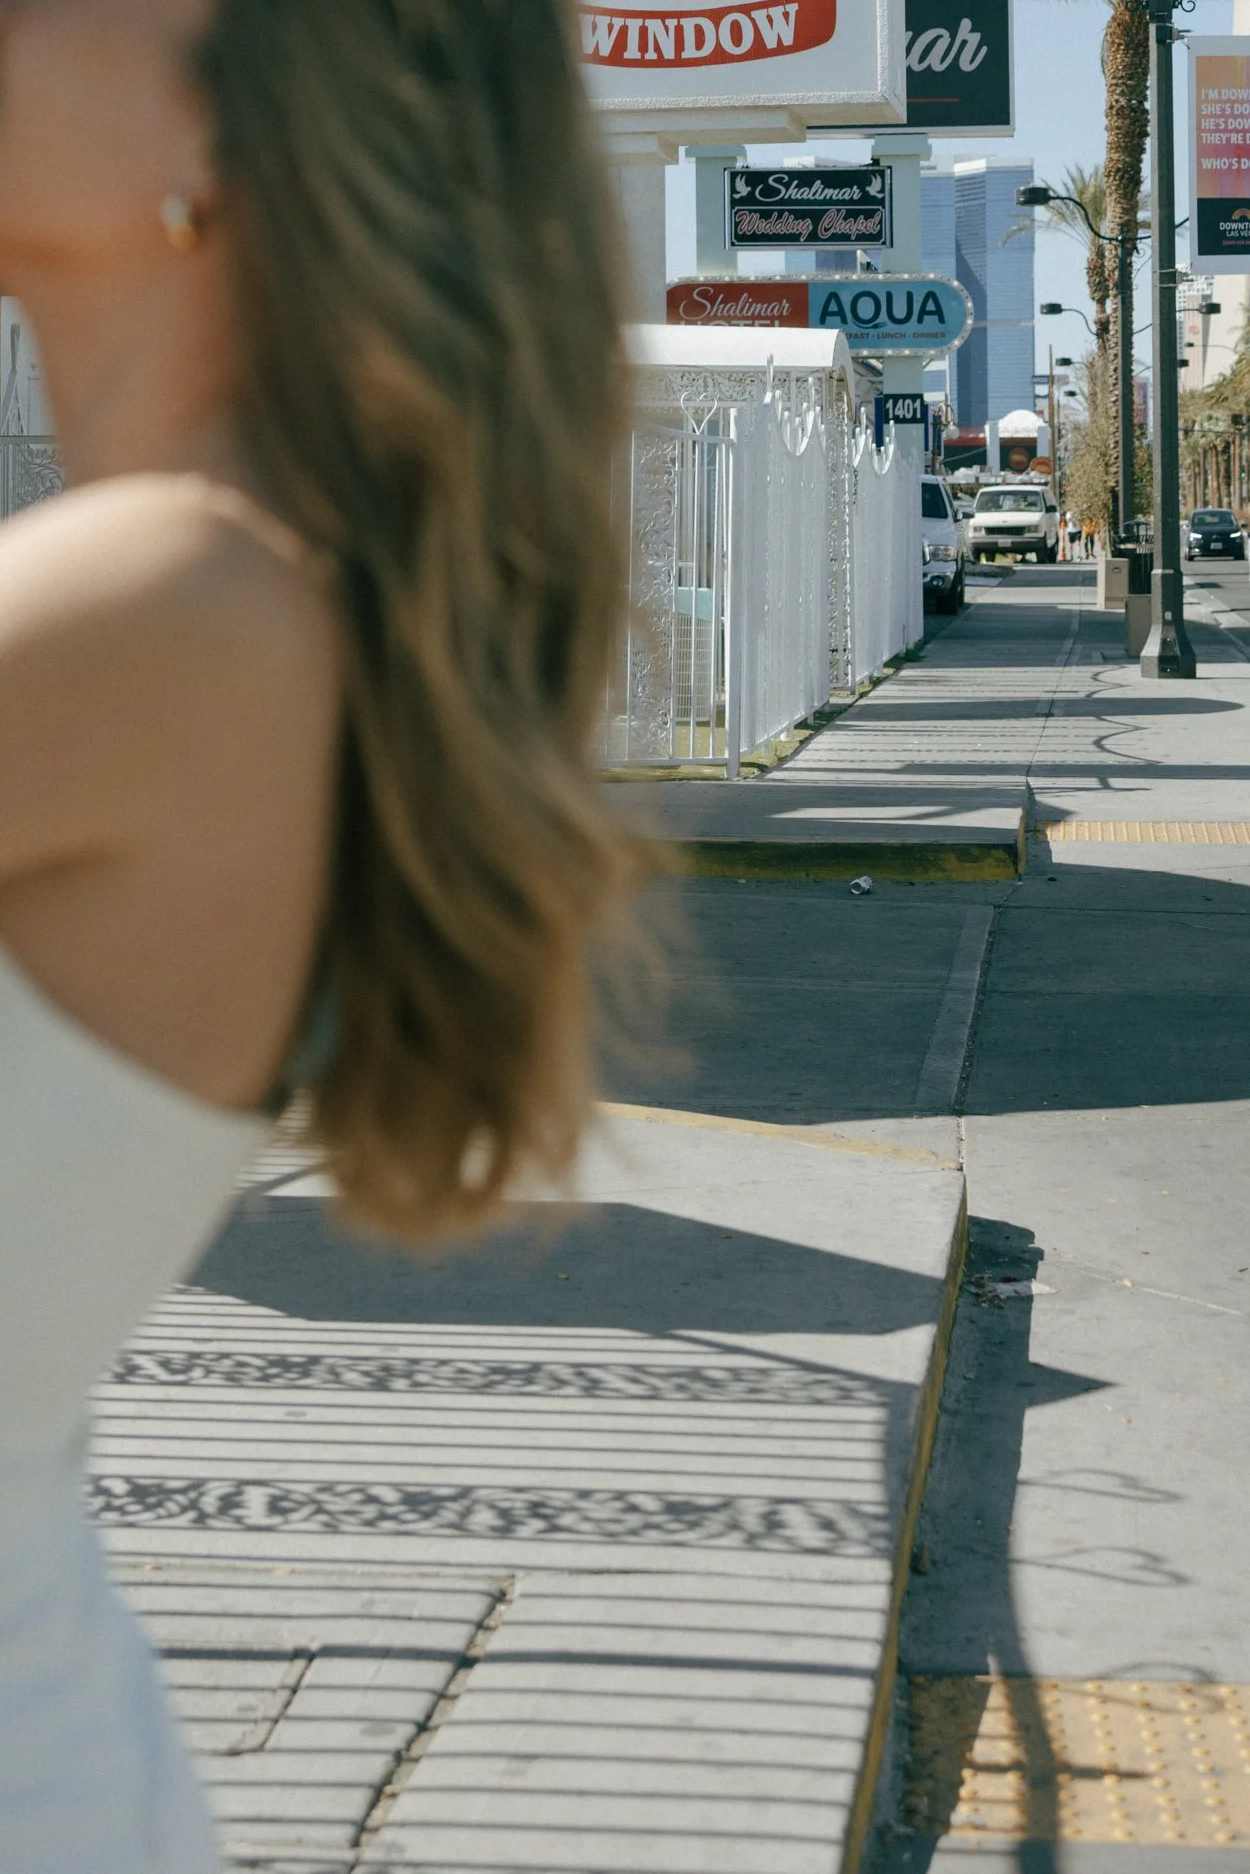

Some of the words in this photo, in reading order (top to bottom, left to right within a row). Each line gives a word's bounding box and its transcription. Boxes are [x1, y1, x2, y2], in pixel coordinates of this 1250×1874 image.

[578, 2, 799, 61] WINDOW
[905, 17, 988, 73] ar
[1201, 88, 1219, 100] I'M
[1221, 88, 1250, 100] DOW
[1201, 103, 1231, 115] SHE'S
[1201, 118, 1225, 130] HE'S
[1201, 133, 1244, 145] THEY'RE
[1201, 158, 1238, 170] WHO'S
[755, 174, 862, 202] Shalimar
[736, 210, 813, 242] Wedding
[817, 208, 881, 241] Chapel
[1219, 221, 1250, 230] DOWNT
[679, 286, 791, 320] Shalimar
[818, 290, 946, 329] AQUA
[877, 332, 906, 340] LUNCH
[913, 332, 946, 340] DINNER
[885, 398, 921, 419] 1401
